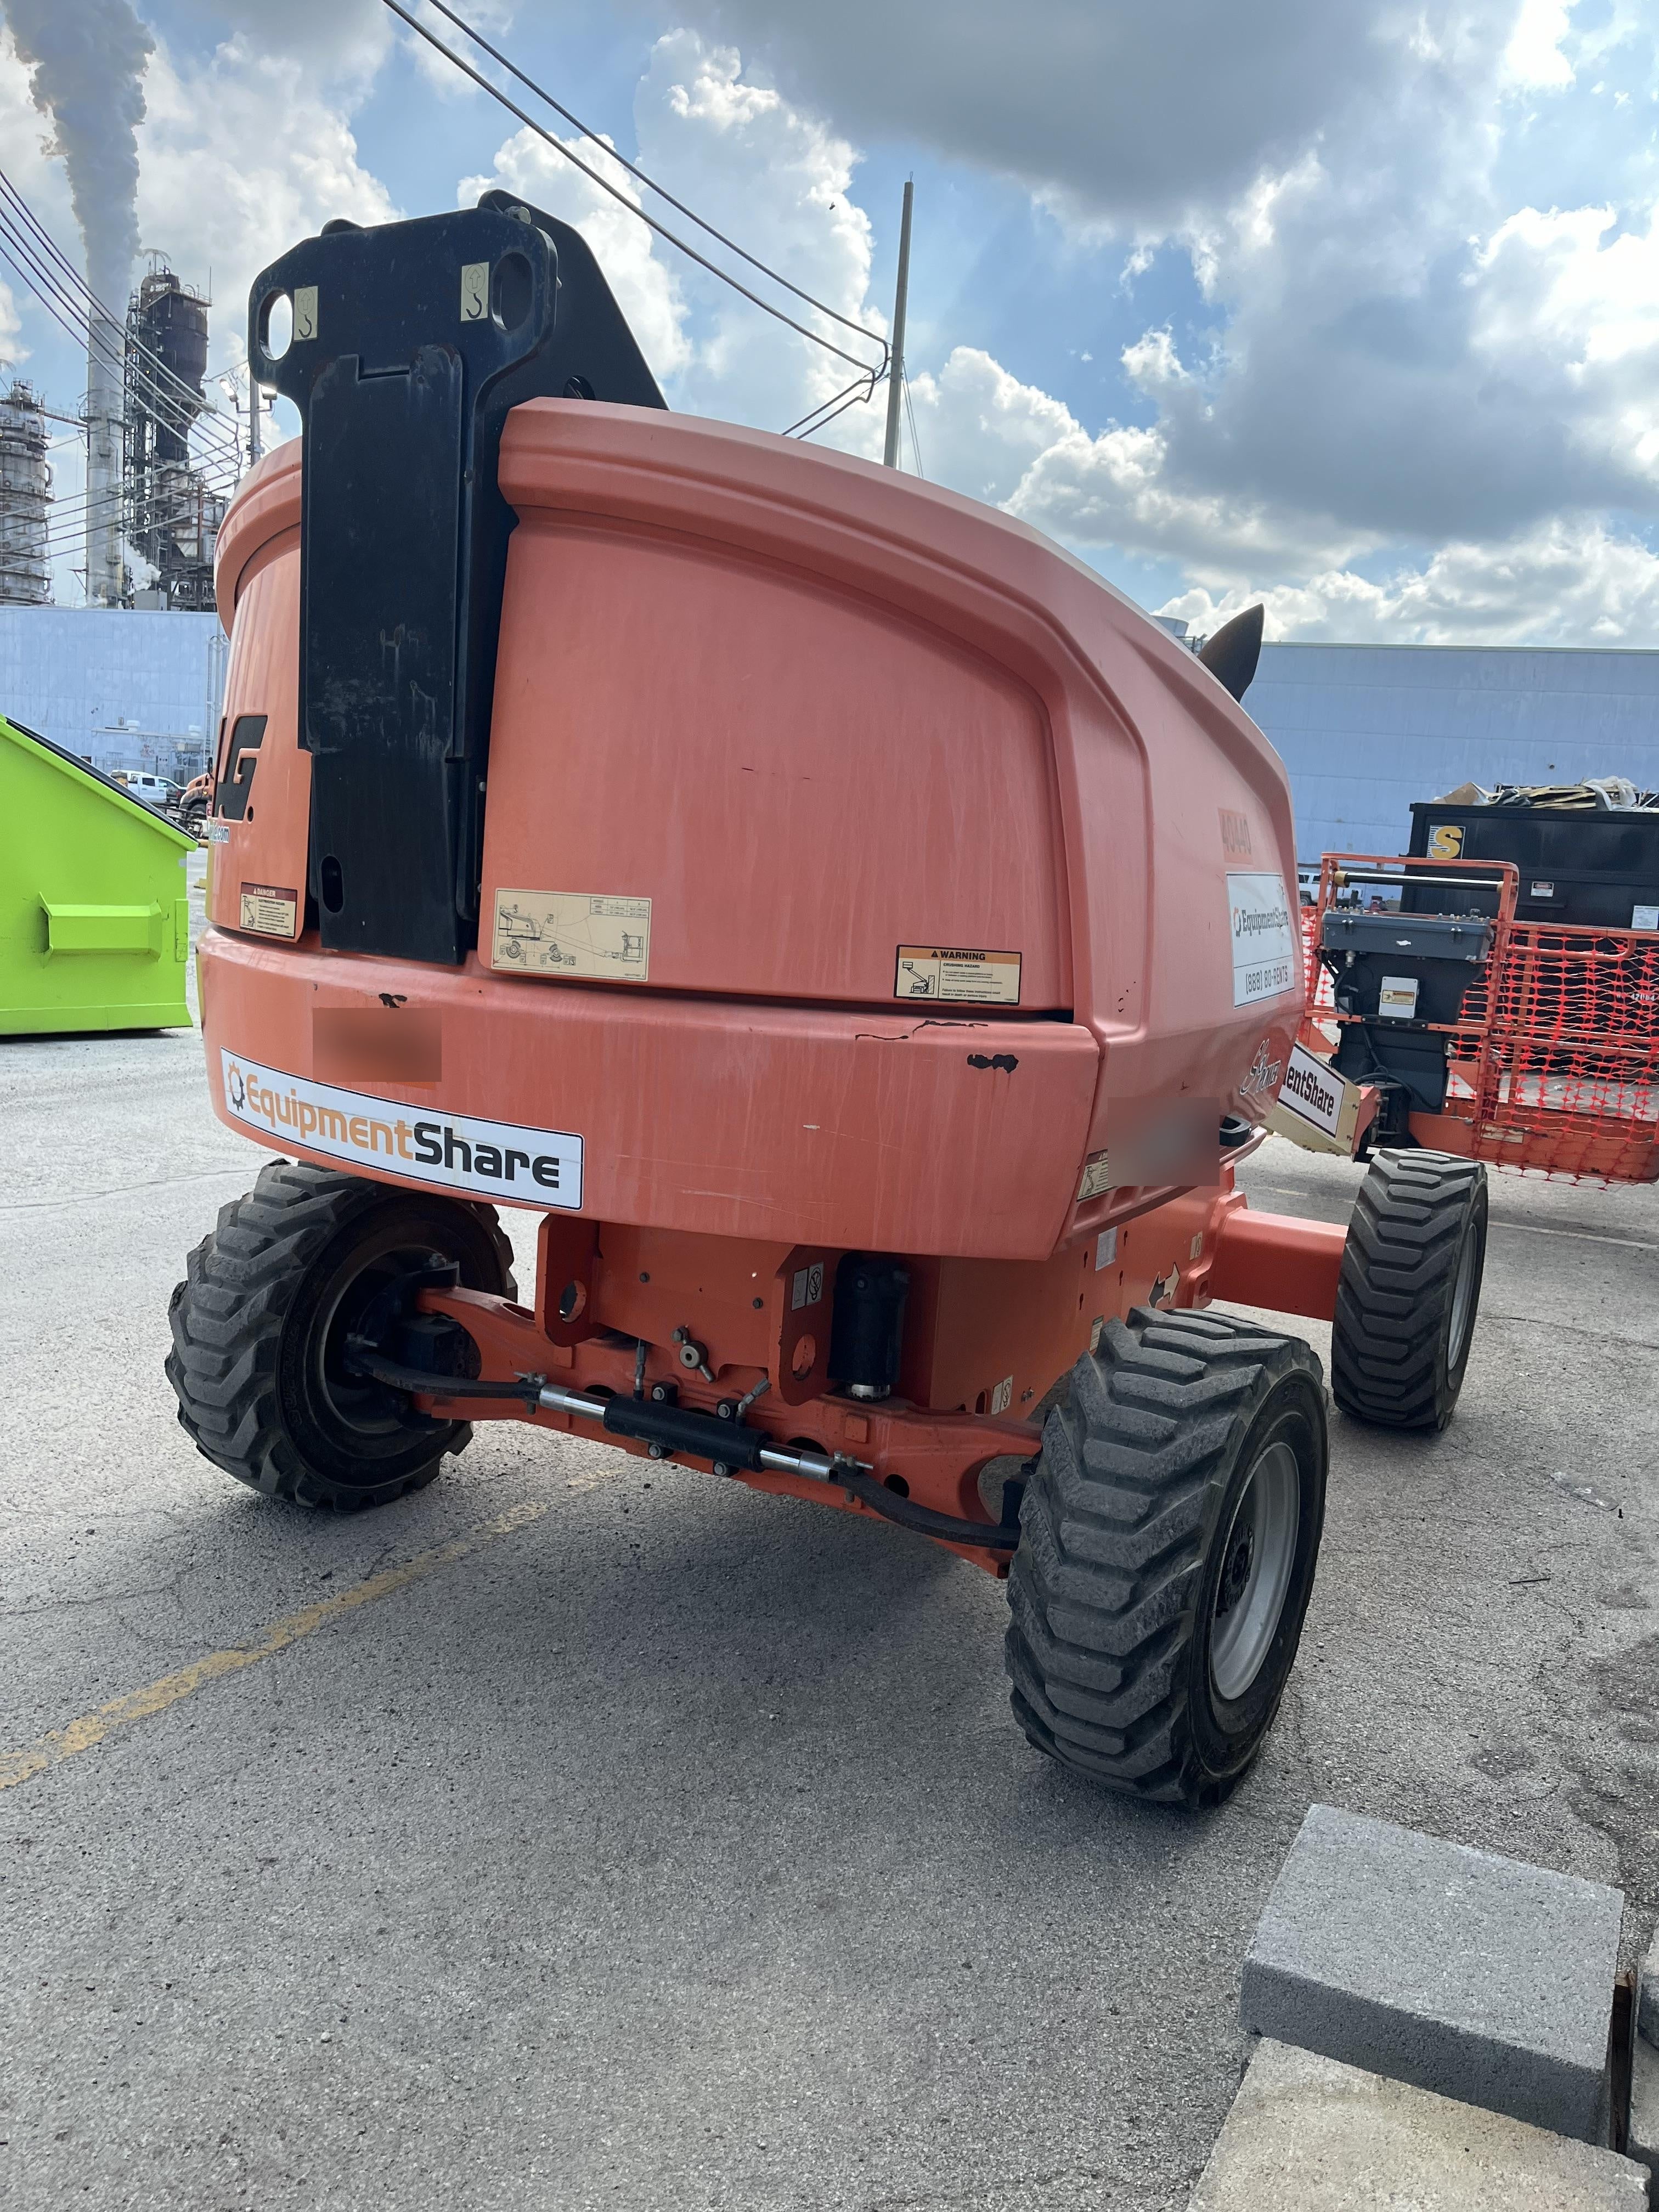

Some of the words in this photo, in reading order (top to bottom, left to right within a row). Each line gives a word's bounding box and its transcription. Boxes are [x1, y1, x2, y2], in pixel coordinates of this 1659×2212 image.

[257, 888, 276, 898] DANGER
[940, 950, 986, 961] WARNING
[1246, 970, 1263, 995] (888)
[1264, 965, 1288, 988] 80-RENTS
[1283, 1066, 1334, 1117] entShare
[246, 1073, 560, 1189] EquipmentShare
